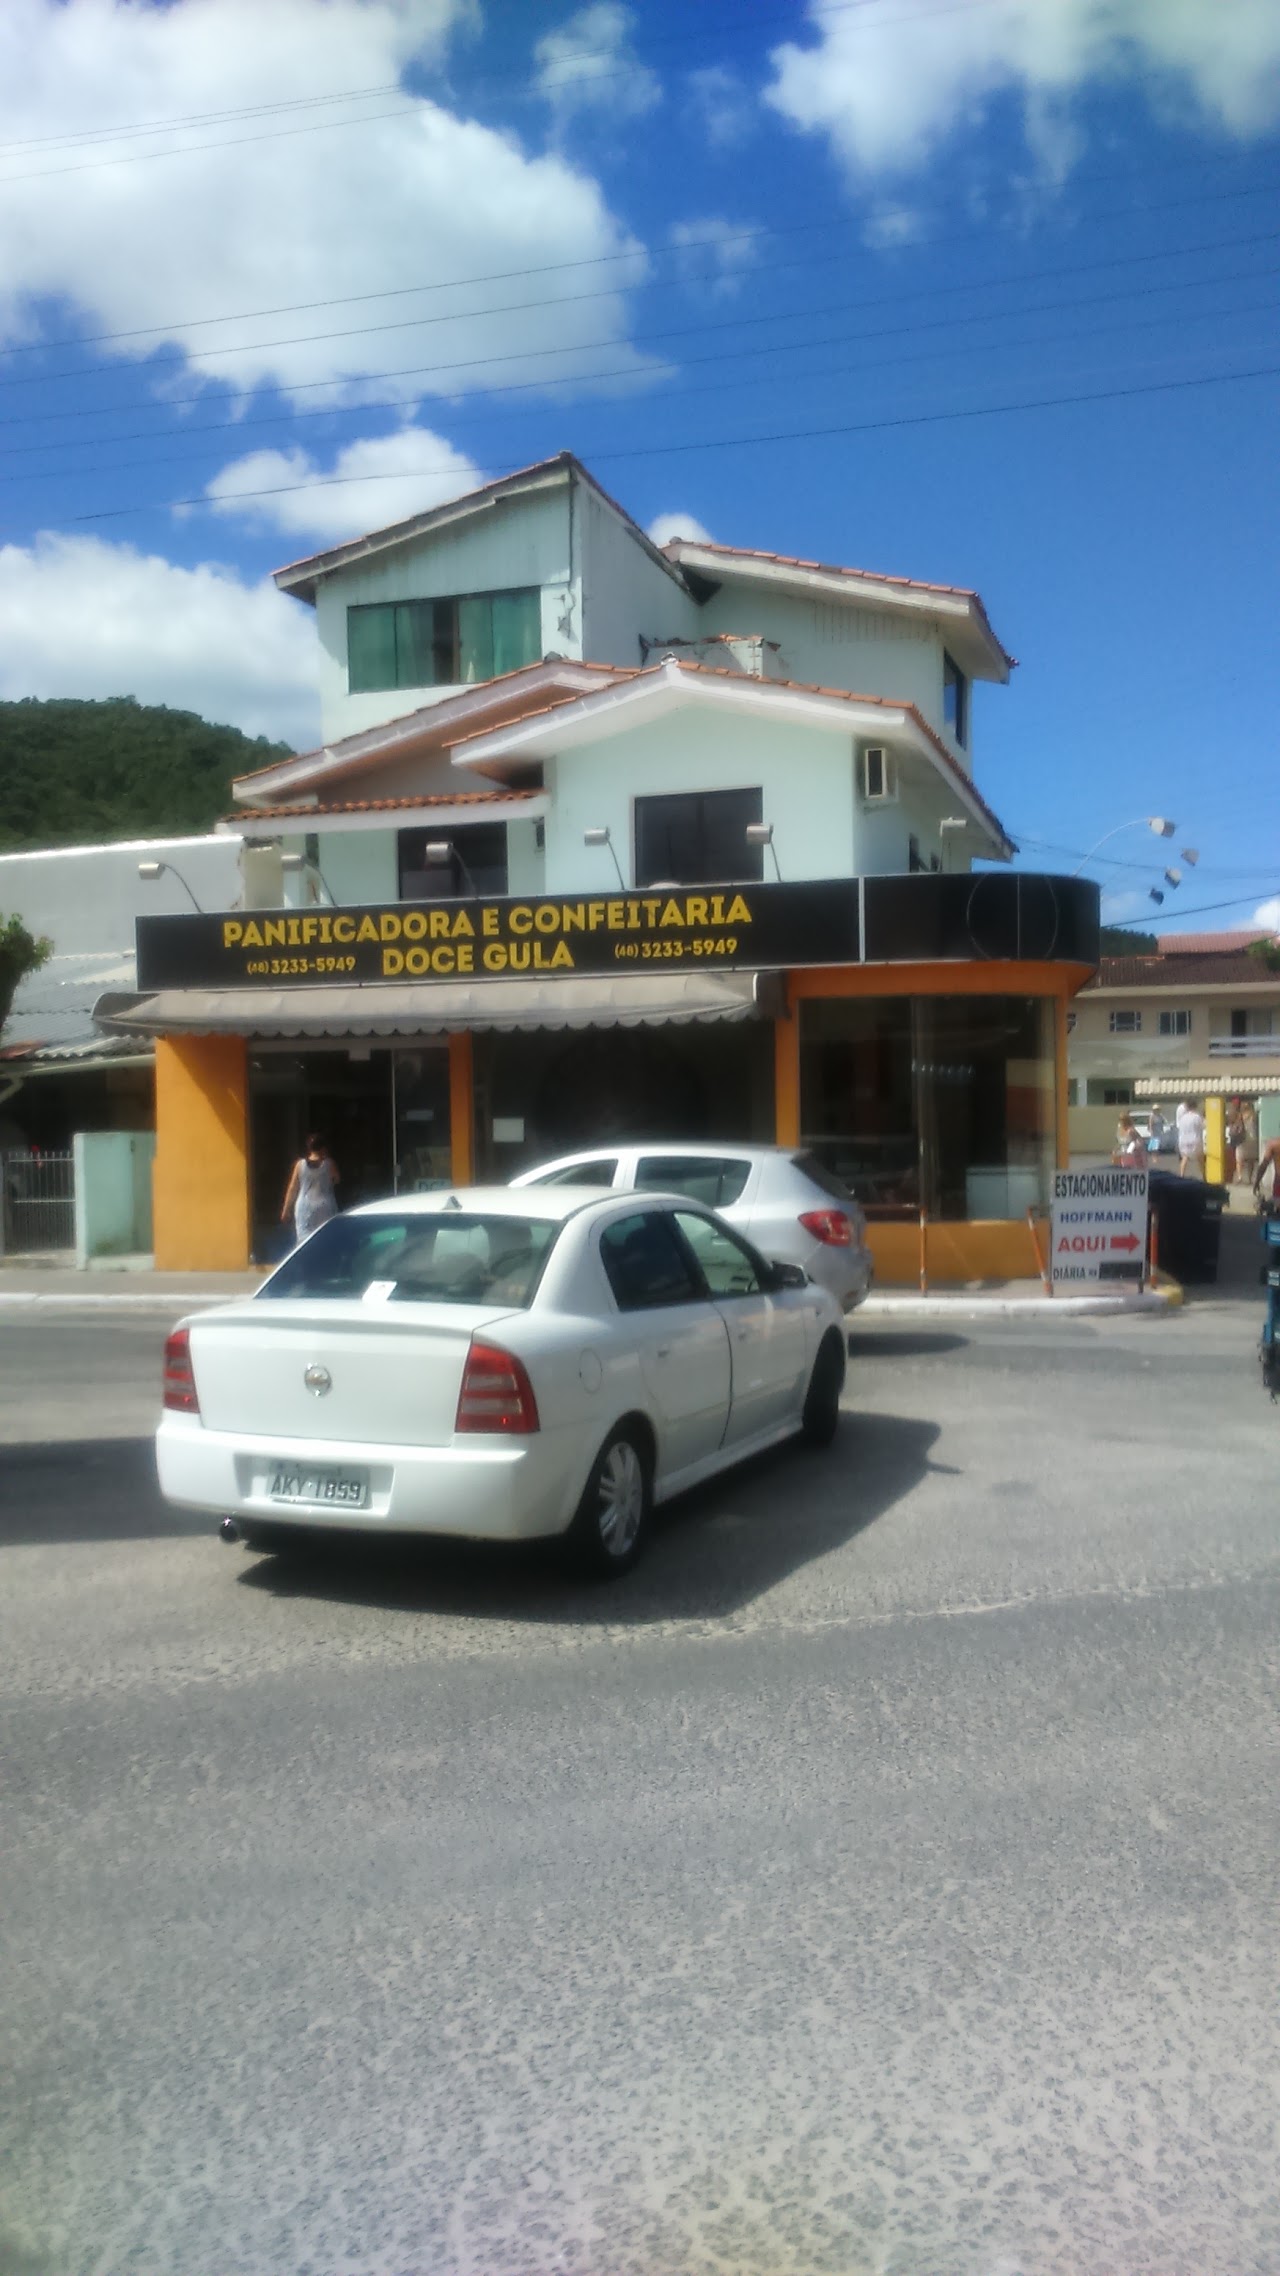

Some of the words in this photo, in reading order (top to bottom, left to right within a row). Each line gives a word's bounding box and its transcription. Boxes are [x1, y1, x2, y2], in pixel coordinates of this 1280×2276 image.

[223, 909, 475, 948] PANIFICADORA
[482, 908, 500, 936] E
[508, 895, 752, 935] CONFEITARIA
[383, 944, 474, 976] DOCE
[483, 940, 575, 971] GULA
[1055, 1174, 1146, 1198] ESTACIONAMENTO
[1060, 1211, 1132, 1223] HOFFMANN
[1058, 1236, 1106, 1253] AQUI
[271, 1474, 306, 1495] AKY
[316, 1475, 361, 1500] 1859
